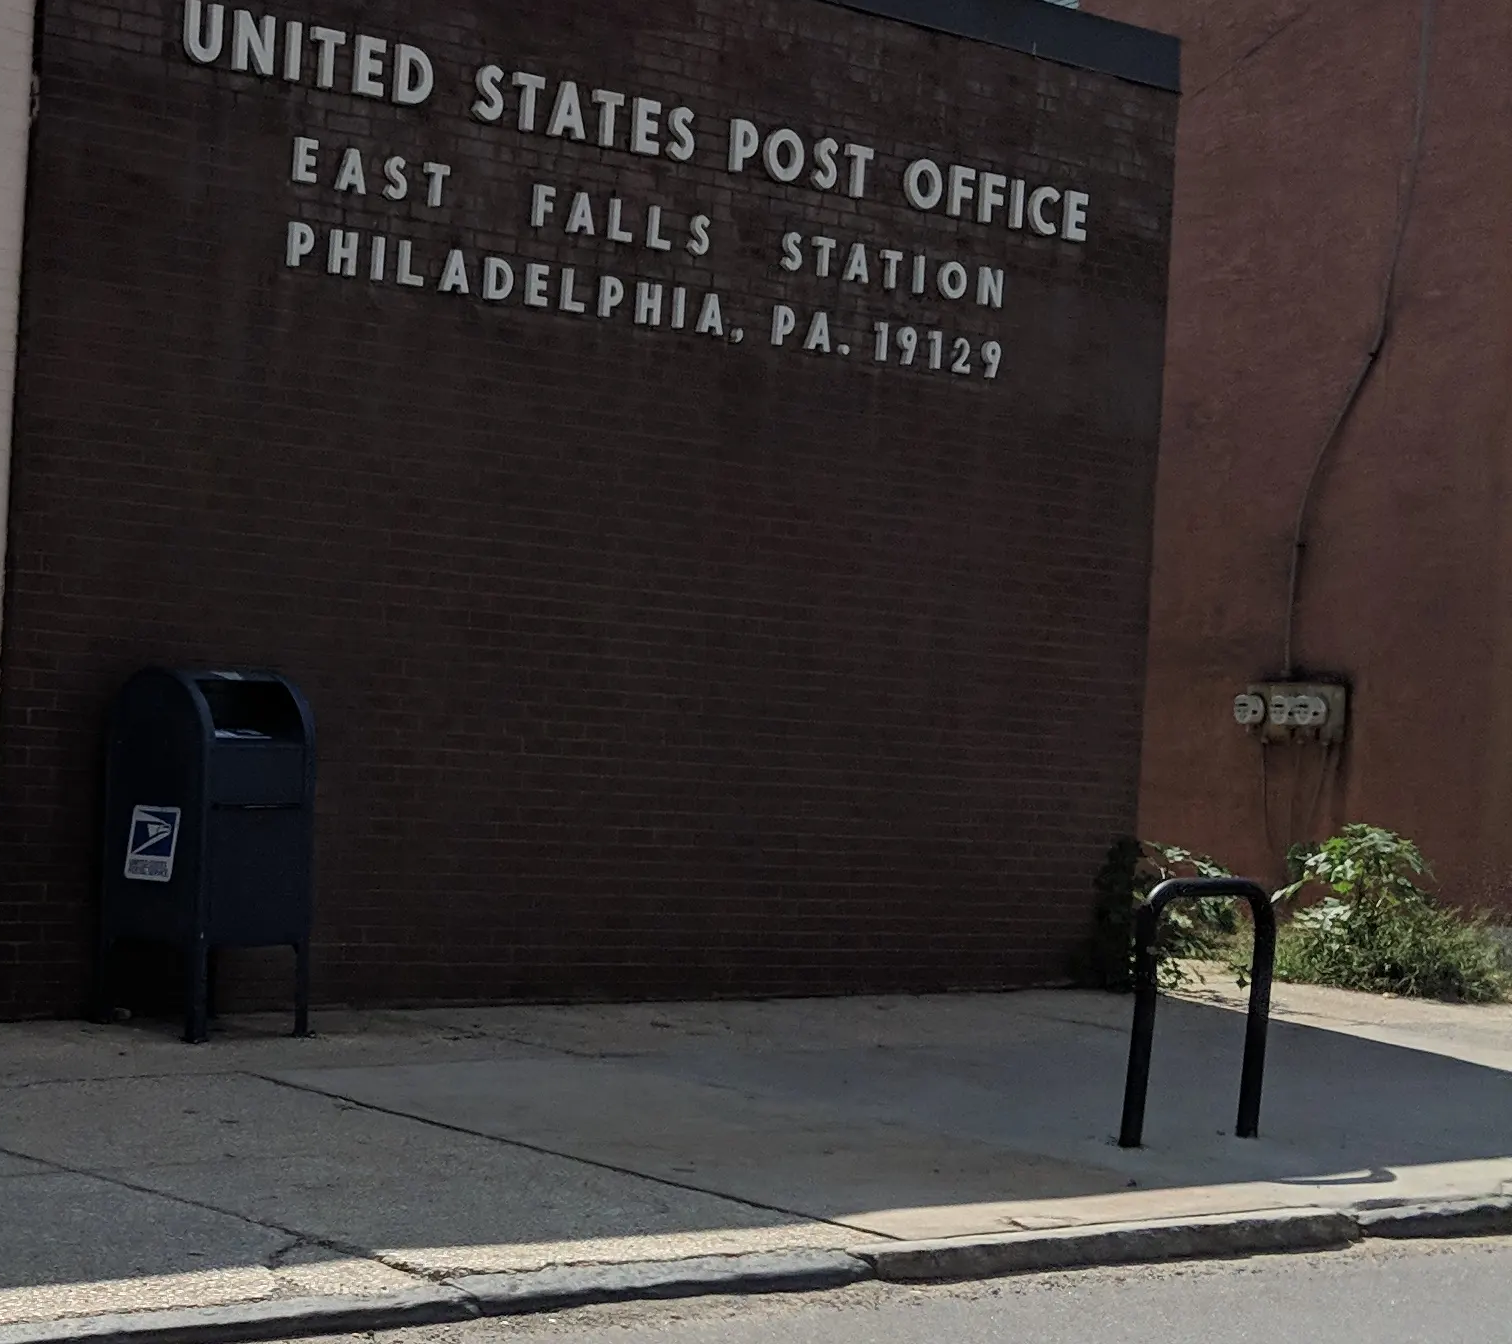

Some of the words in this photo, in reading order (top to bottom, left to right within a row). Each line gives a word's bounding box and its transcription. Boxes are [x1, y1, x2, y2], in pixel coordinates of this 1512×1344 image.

[292, 136, 451, 207] EAST
[531, 184, 711, 255] FALLS
[780, 231, 1004, 308] STATION
[472, 64, 695, 161] STATES
[728, 118, 875, 198] POST
[903, 158, 1090, 242] OFFICE
[286, 221, 744, 343] PHILADELPHIA,
[770, 304, 851, 356] PA.
[874, 321, 1002, 379] 19129
